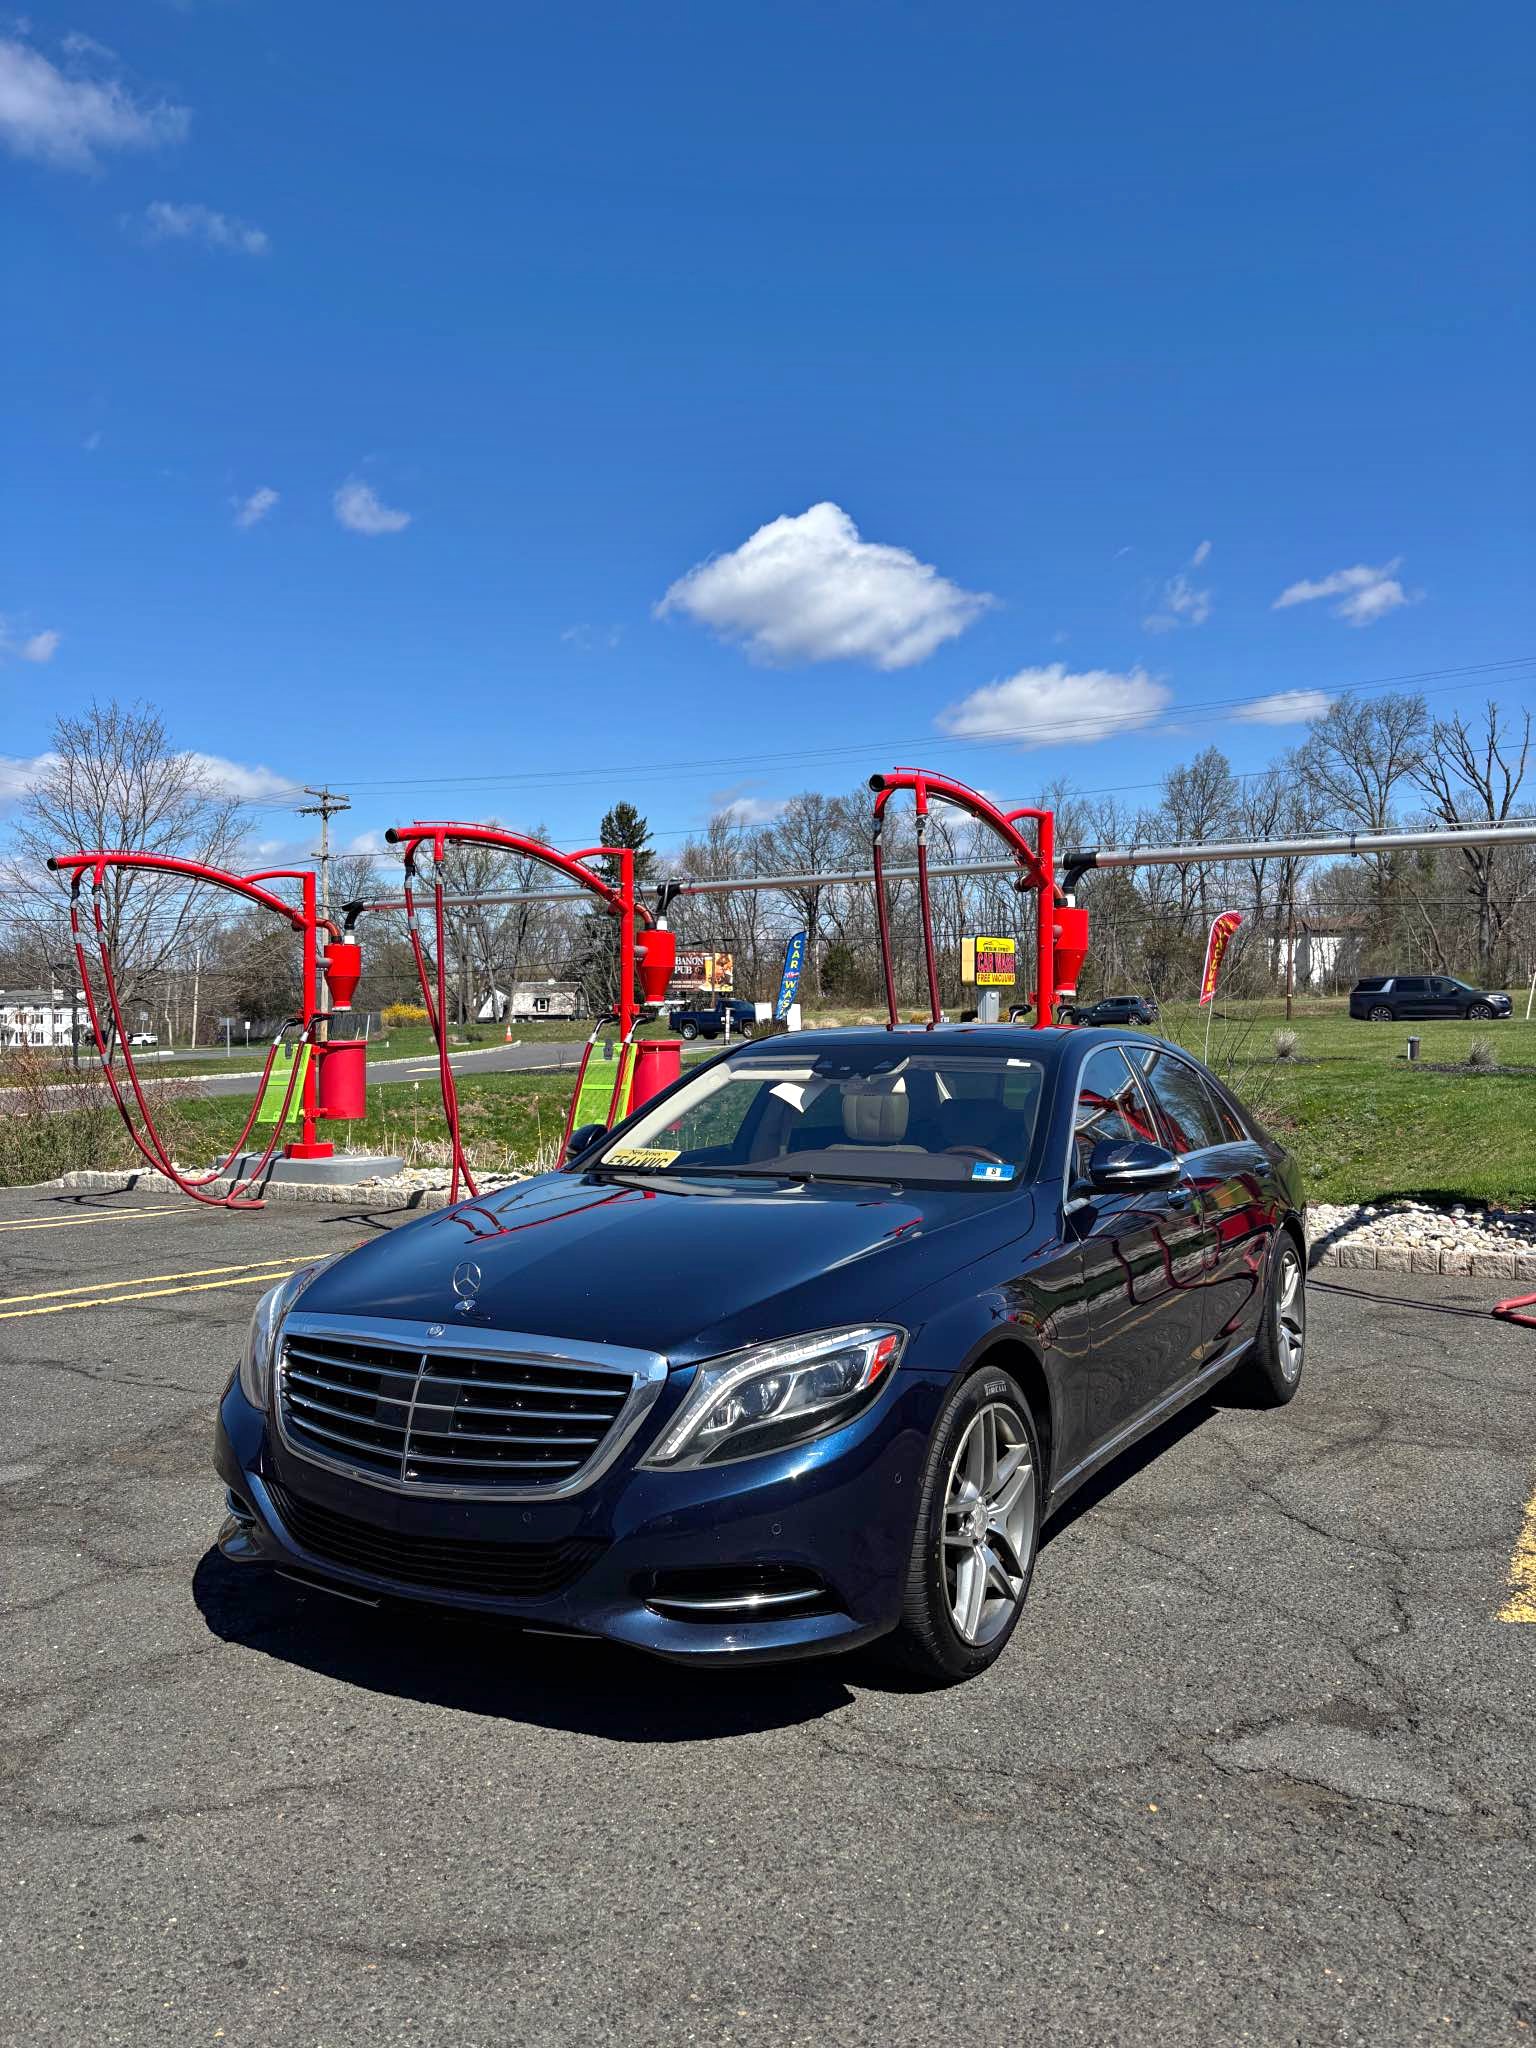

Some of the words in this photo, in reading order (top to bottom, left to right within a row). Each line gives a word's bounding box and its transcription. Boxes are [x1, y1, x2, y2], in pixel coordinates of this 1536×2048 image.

[790, 940, 801, 969] CAR
[675, 955, 704, 966] BANON
[977, 952, 994, 973] CAR
[995, 952, 1015, 974] WASH
[674, 965, 693, 975] PUB
[977, 973, 991, 983] FREE
[991, 1167, 997, 1175] 8
[983, 1380, 1007, 1397] PIRELLI
